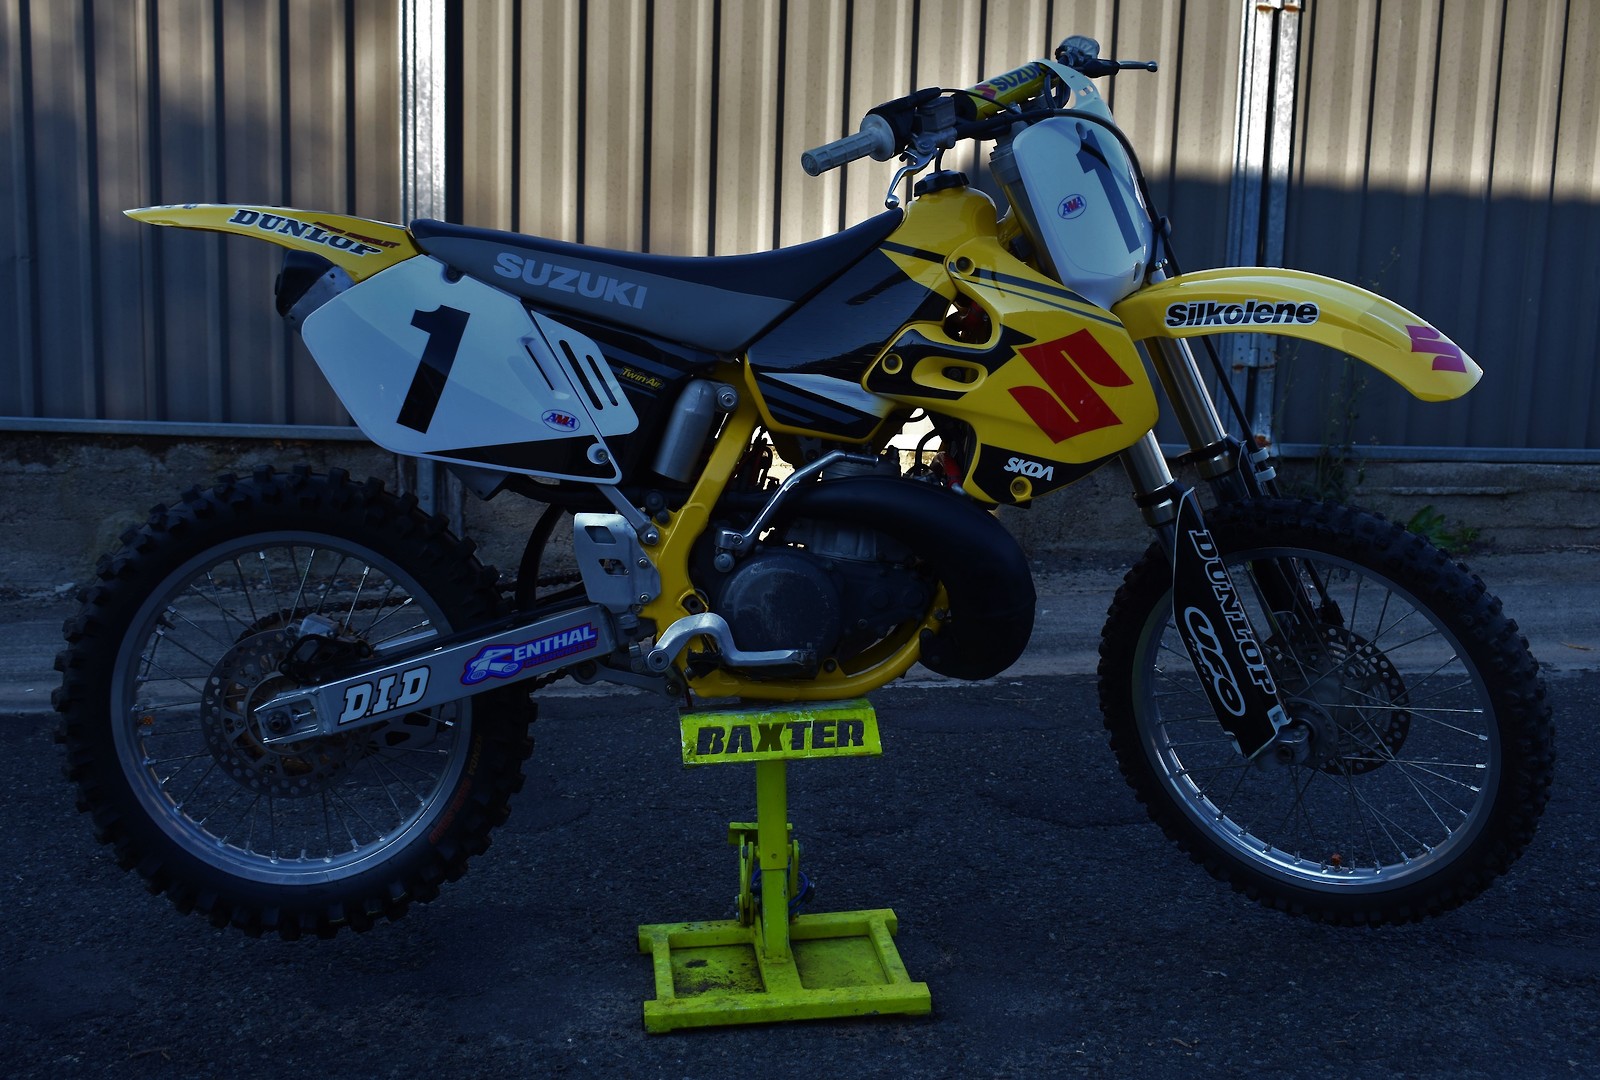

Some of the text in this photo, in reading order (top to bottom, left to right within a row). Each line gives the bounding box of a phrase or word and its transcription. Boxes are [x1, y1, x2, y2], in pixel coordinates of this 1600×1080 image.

[1061, 196, 1084, 216] AMA
[1076, 129, 1142, 253] 1
[228, 209, 382, 257] DUNLOP
[493, 252, 648, 310] SUZUKI
[396, 304, 471, 434] 1
[544, 412, 576, 429] AMA
[1003, 456, 1055, 482] SKDA
[1188, 529, 1277, 696] DUNLOP
[468, 626, 596, 682] RENTHAL
[1184, 606, 1246, 717] UFO
[696, 720, 865, 755] BAXTER
